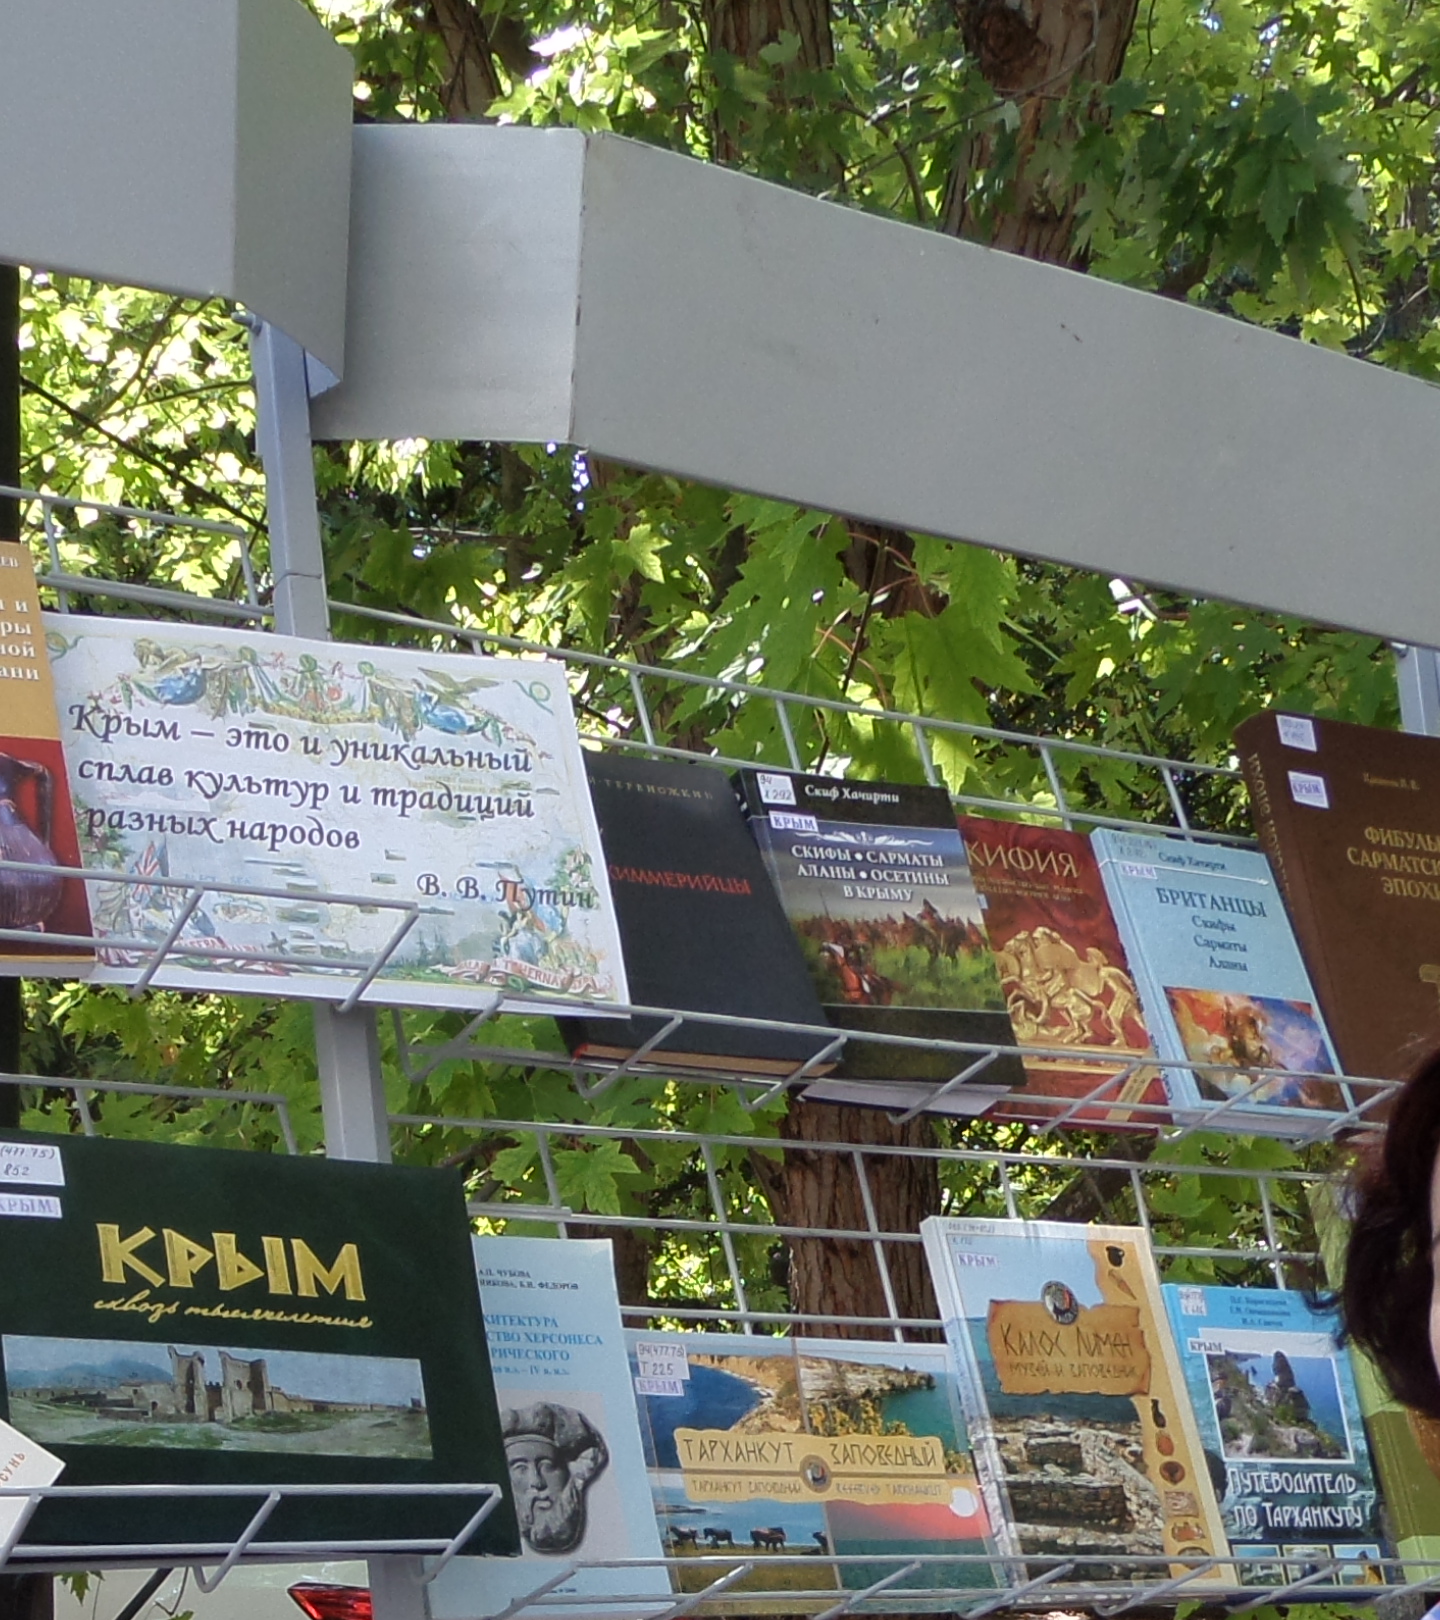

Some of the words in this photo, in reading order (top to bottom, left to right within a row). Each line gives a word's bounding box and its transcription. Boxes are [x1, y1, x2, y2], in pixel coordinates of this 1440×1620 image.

[68, 703, 182, 743] Крым
[225, 722, 291, 755] это
[328, 736, 533, 774] уникальный
[77, 757, 175, 787] сплав
[184, 769, 329, 808] культур
[371, 781, 535, 823] традиций
[805, 784, 839, 801] Скиф
[84, 805, 225, 845] разных
[227, 815, 361, 855] народов
[772, 815, 816, 831] КРЫМ
[792, 845, 851, 862] СКИФЫ
[866, 851, 944, 867] САРМАТЫ
[798, 864, 856, 880] АЛАНЫ
[871, 869, 950, 885] ОСЕТИНЫ
[495, 879, 598, 911] Путин
[856, 886, 913, 901] КРЫМУ
[1155, 886, 1267, 919] БРИТАНЦЫ
[1191, 914, 1237, 934] Скифы
[95, 1222, 366, 1302] КРЫМ
[958, 1253, 997, 1268] КРЫМ
[525, 1332, 603, 1345] ХЕРСОНЕСА
[1189, 1339, 1223, 1354] КРЫМ
[639, 1380, 680, 1394] КРЫМ
[683, 1439, 793, 1463] ТАРХАНКУТ
[830, 1442, 936, 1467] ЗАПОВЕДНЫЙ
